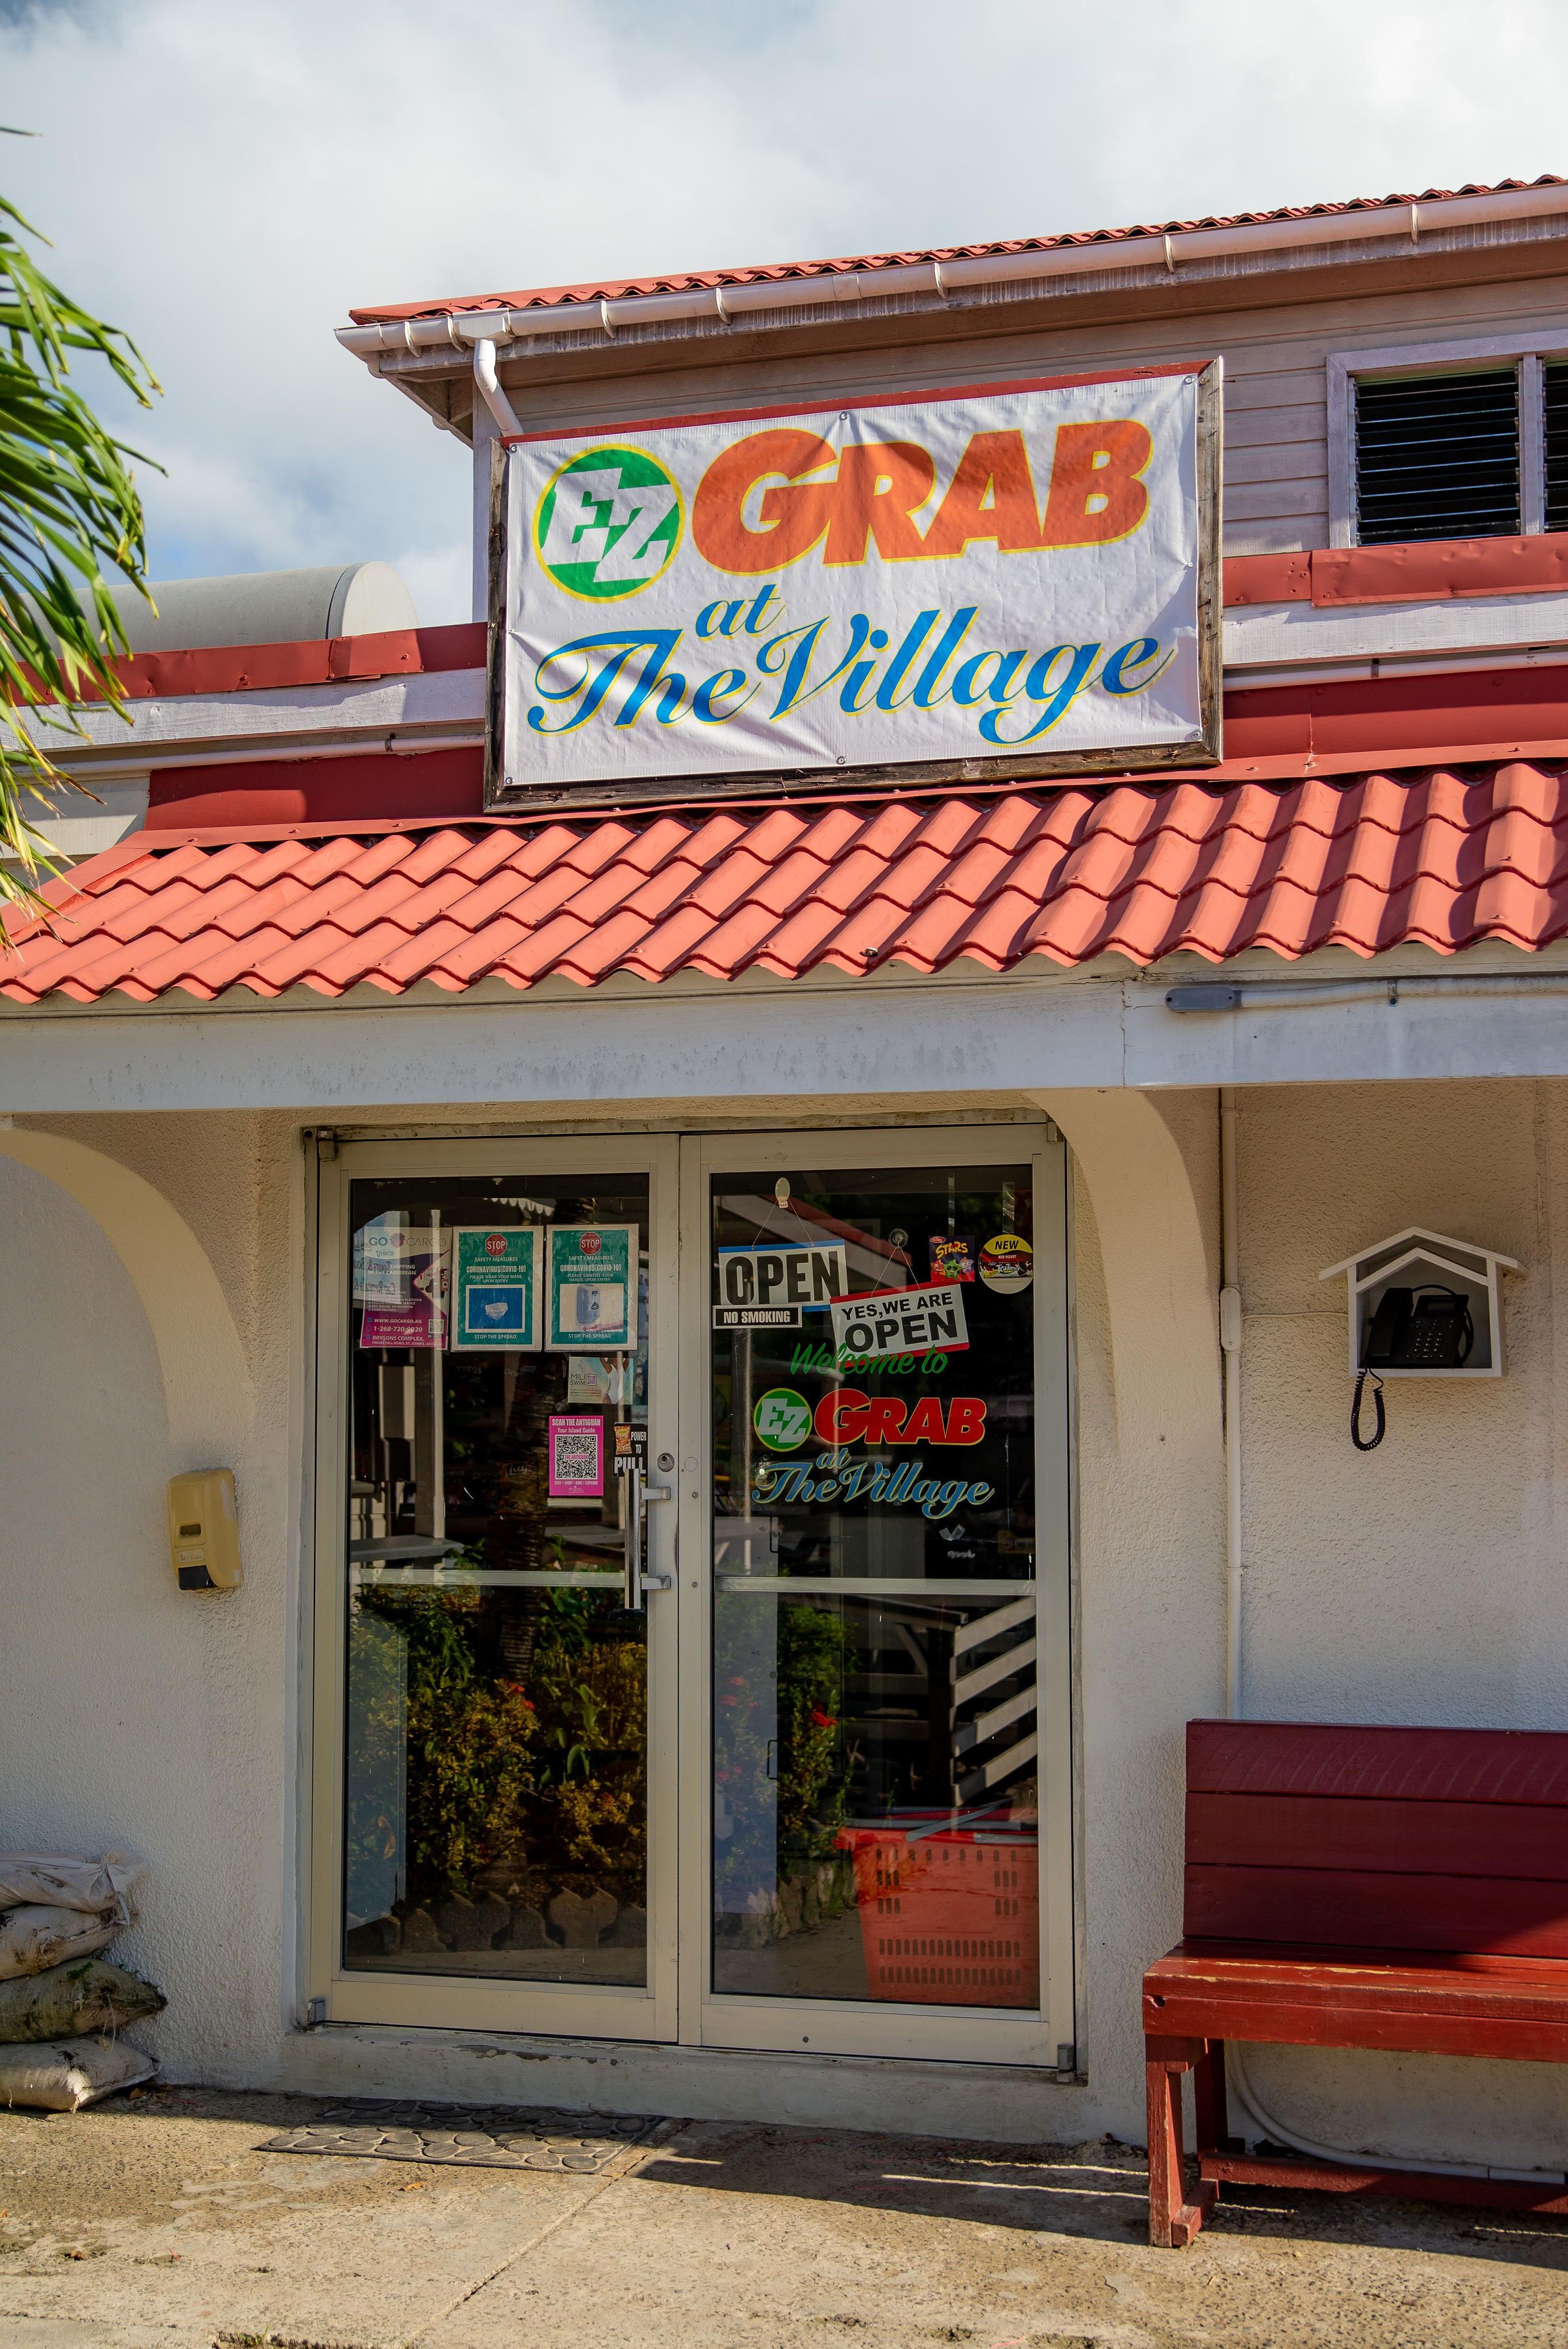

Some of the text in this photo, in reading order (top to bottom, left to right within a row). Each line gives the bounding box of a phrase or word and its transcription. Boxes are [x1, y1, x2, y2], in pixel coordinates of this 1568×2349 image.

[541, 418, 1154, 583] EZ GRAB
[696, 585, 785, 639] at
[527, 604, 1174, 748] The Village
[369, 1237, 447, 1248] GO CARGO
[487, 1241, 506, 1250] STOP
[581, 1240, 600, 1248] STOP
[936, 1240, 968, 1259] STARS
[994, 1240, 1019, 1250] NEW
[725, 1251, 841, 1306] OPEN
[916, 1292, 953, 1310] ARE
[724, 1310, 791, 1324] NO SMOKING
[844, 1309, 959, 1353] OPEN
[790, 1343, 949, 1375] Welcome to
[757, 1388, 987, 1446] EZ GRAB
[631, 1432, 647, 1441] POWER
[636, 1444, 641, 1454] TO
[816, 1447, 852, 1469] at
[752, 1462, 995, 1520] The Village
